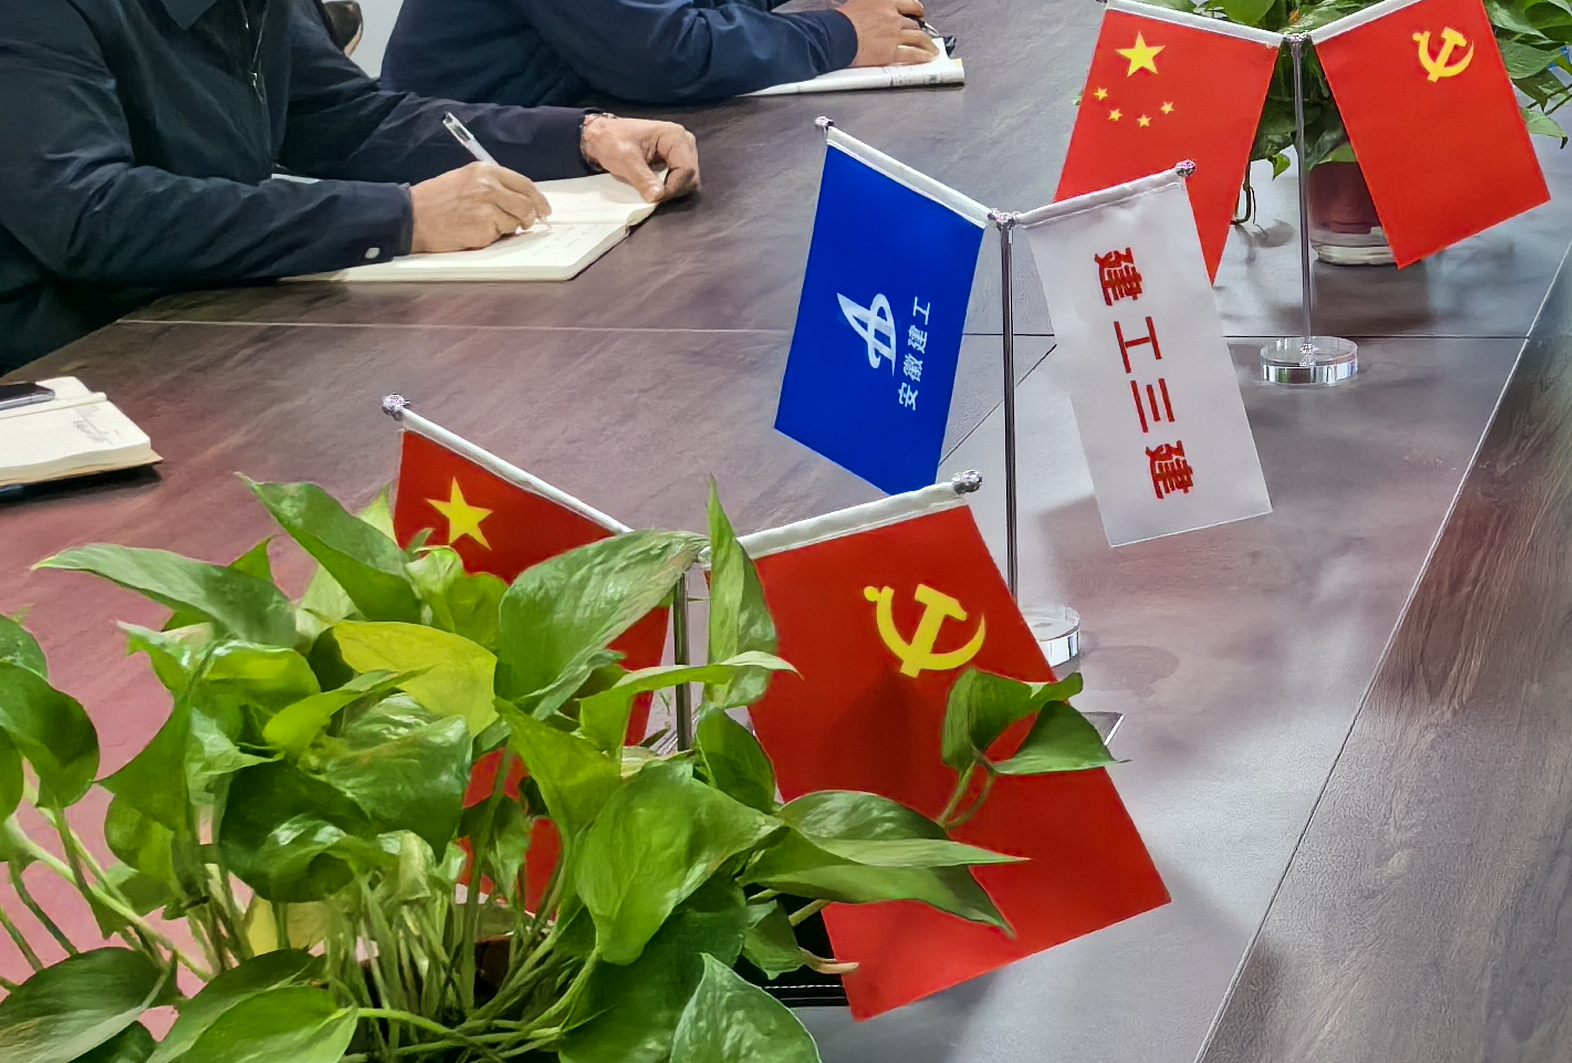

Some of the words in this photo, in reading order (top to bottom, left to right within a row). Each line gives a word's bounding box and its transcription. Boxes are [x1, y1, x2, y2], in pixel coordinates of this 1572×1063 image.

[897, 295, 932, 412] 安徽建工
[1094, 246, 1196, 501] 建工三建
